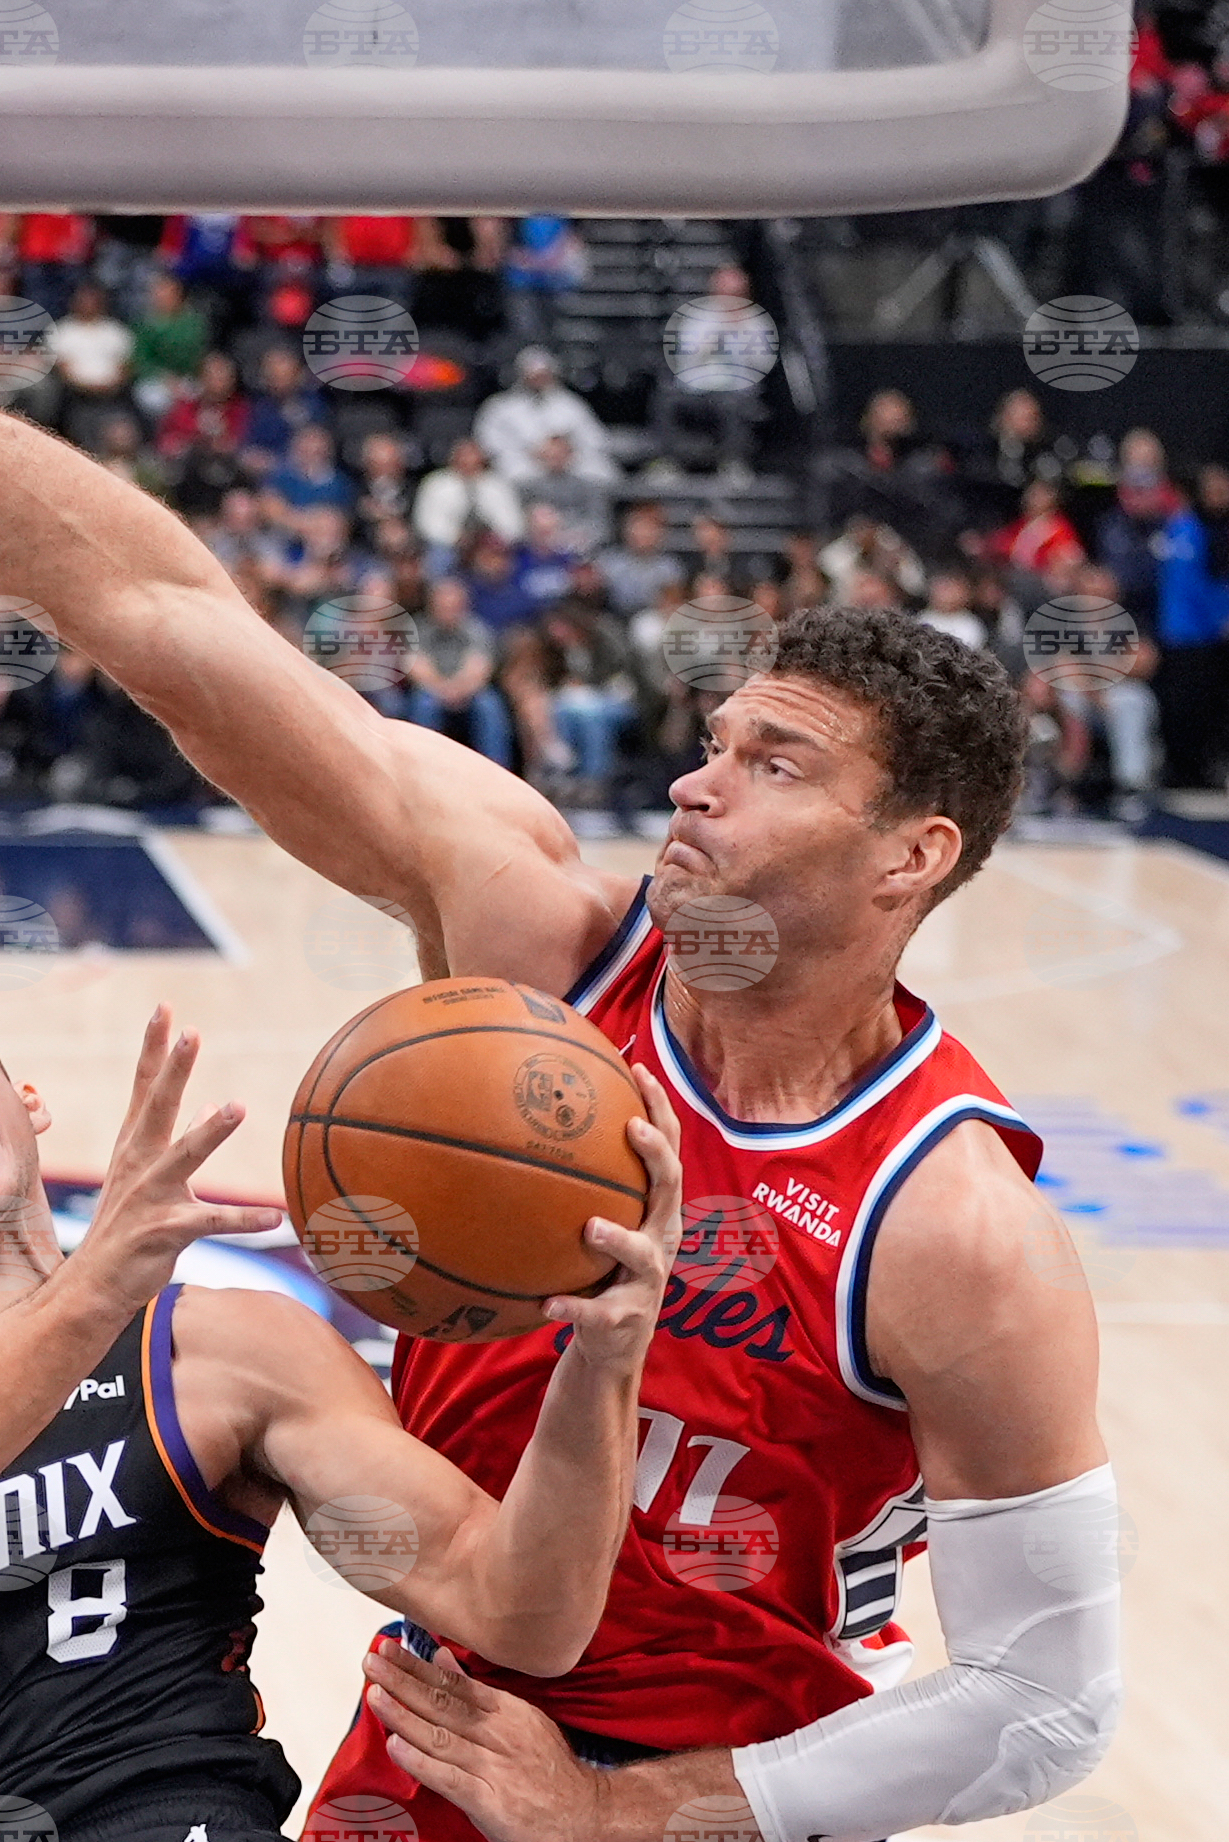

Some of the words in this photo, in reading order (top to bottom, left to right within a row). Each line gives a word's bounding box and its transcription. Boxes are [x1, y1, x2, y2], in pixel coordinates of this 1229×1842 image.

[752, 1182, 842, 1247] RWANDA
[786, 1177, 840, 1222] VISIT
[47, 1558, 128, 1664] 8
